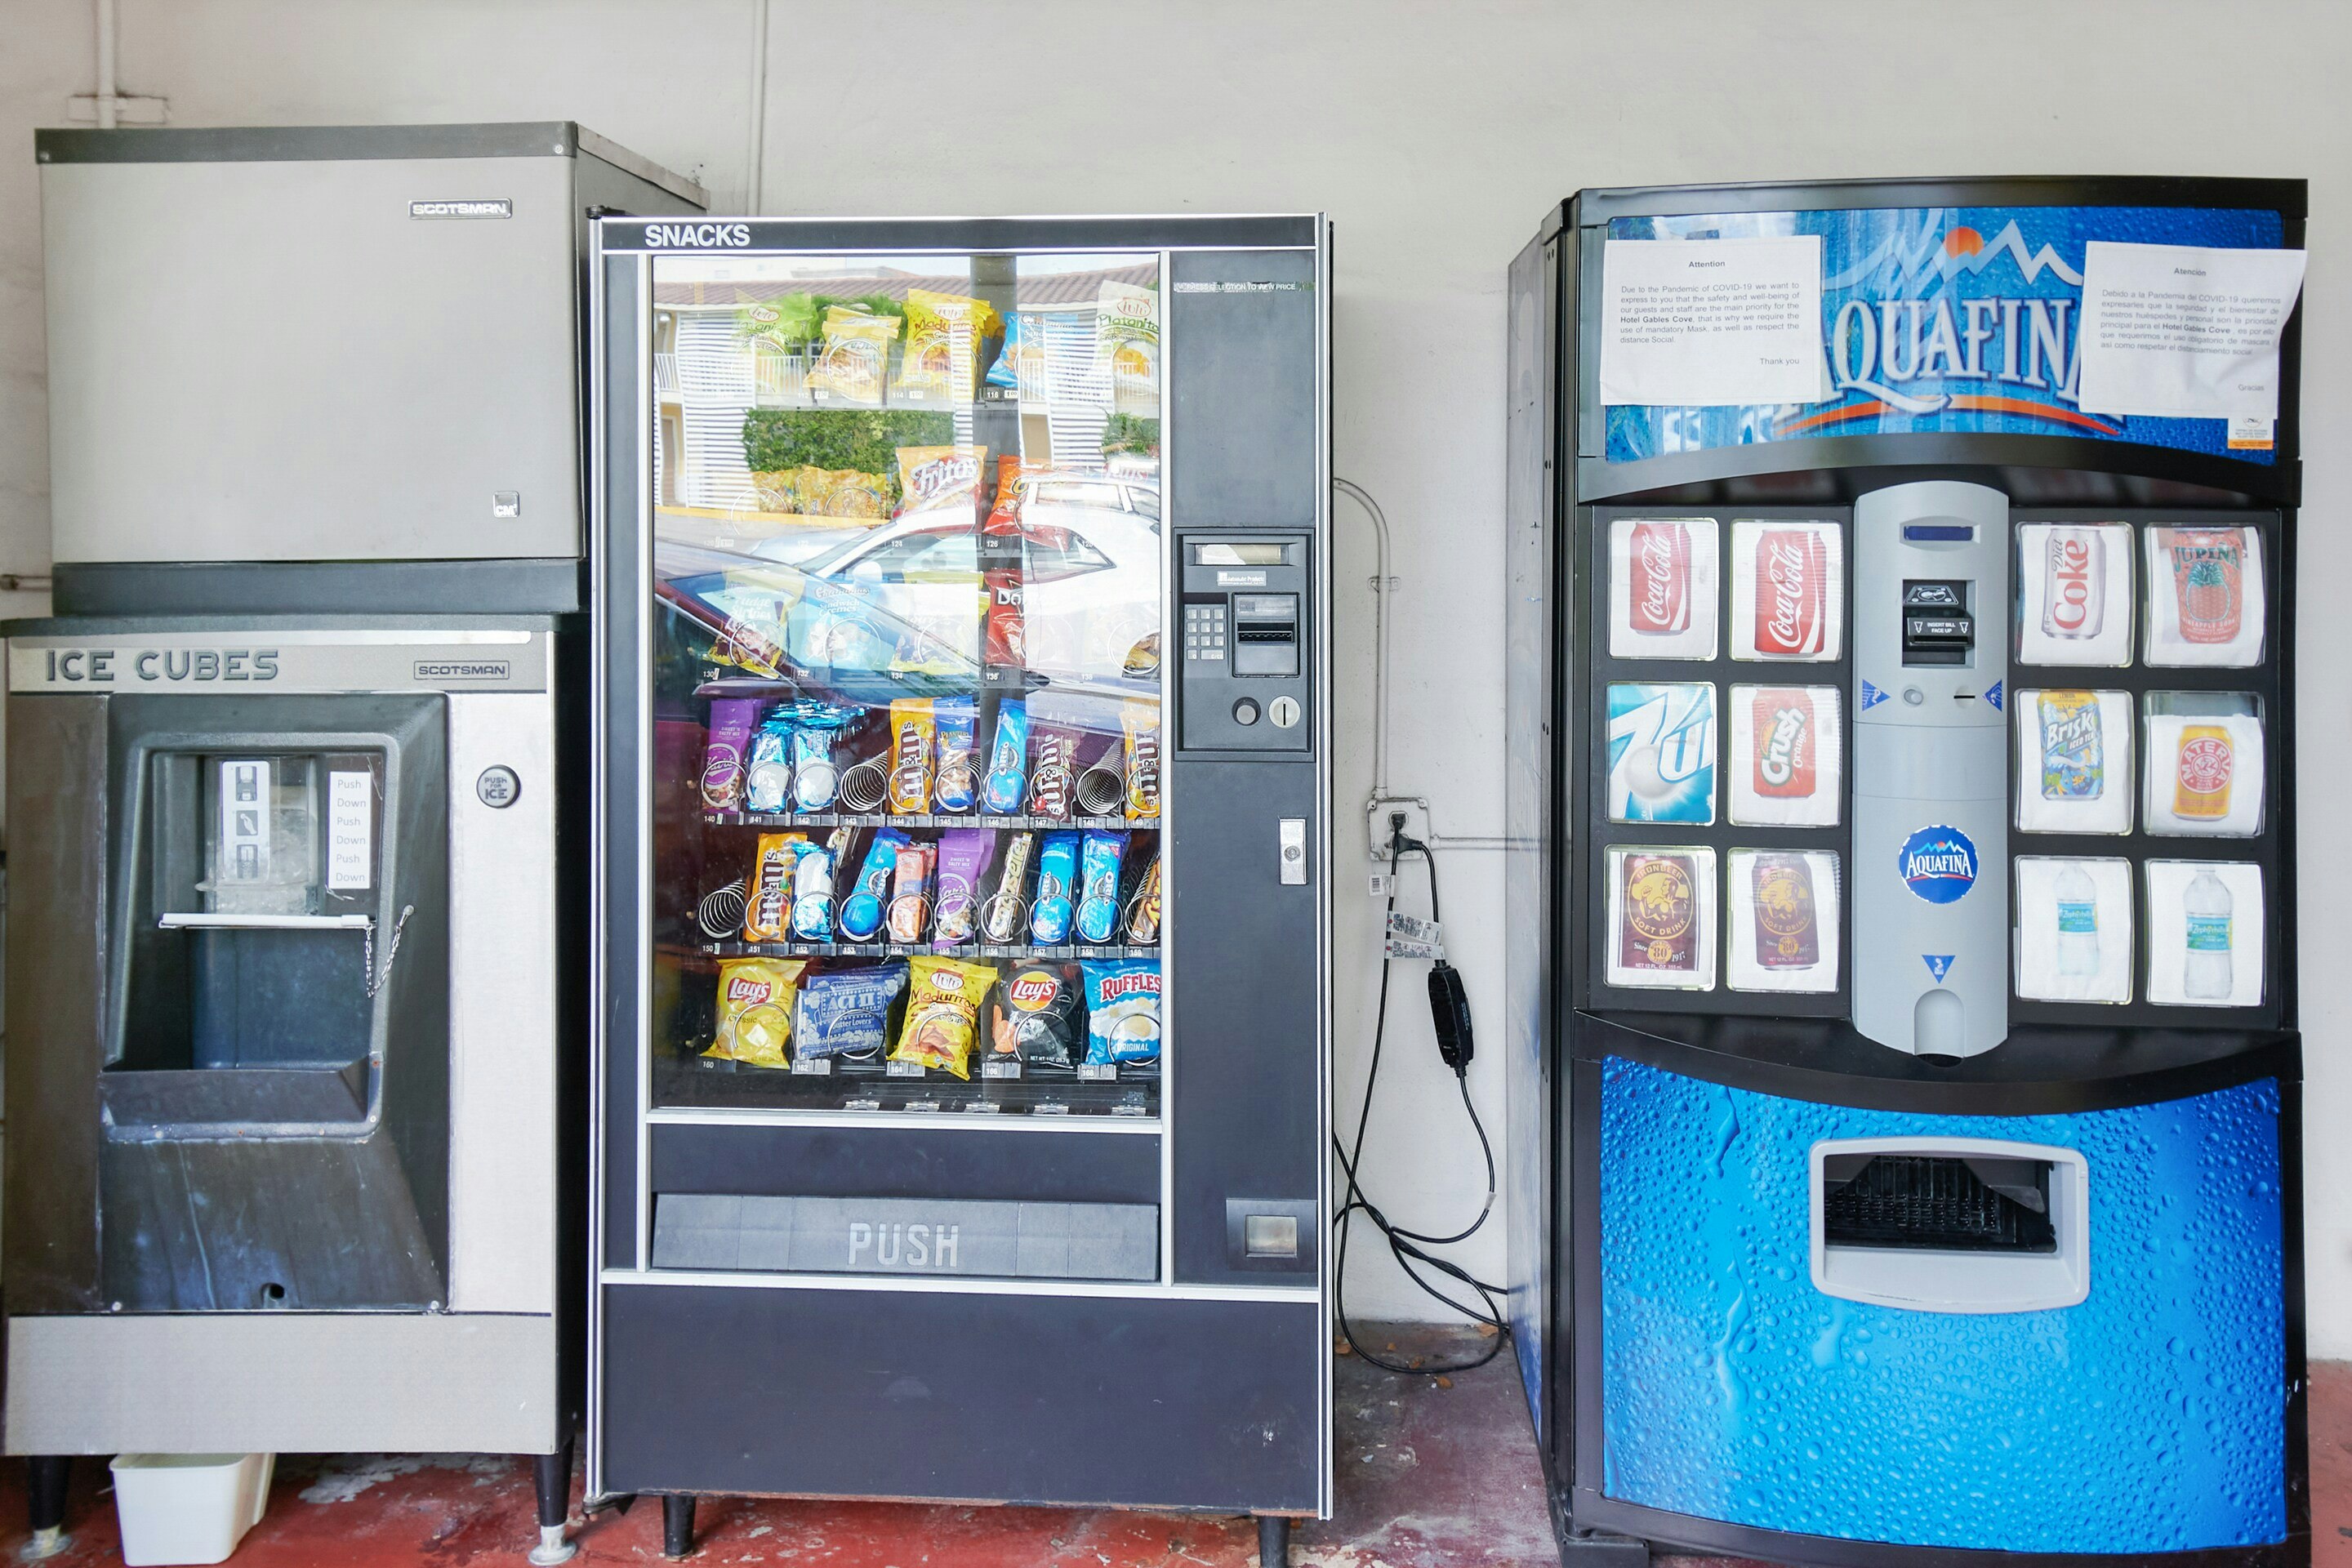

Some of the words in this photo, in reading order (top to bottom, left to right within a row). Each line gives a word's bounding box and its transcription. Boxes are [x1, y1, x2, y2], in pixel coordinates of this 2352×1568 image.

[412, 203, 506, 215] SCOTSMAN
[645, 225, 751, 247] SNACKS
[1688, 260, 1725, 268] Attention
[1276, 283, 1296, 291] PRICE
[1621, 285, 1635, 293] Due
[1638, 285, 1645, 293] to
[1662, 284, 1699, 292] Pandemic
[1702, 283, 1709, 292] of
[1713, 283, 1752, 292] COVID-19
[1770, 282, 1788, 290] want
[1792, 282, 1799, 290] to
[1620, 296, 1647, 305] express
[1650, 295, 1657, 303] to
[1659, 296, 1673, 305] you
[1675, 294, 1690, 302] that
[1692, 294, 1704, 302] the
[1707, 293, 1730, 303] safety
[1749, 292, 1788, 302] well-being
[1792, 292, 1799, 300] of
[1634, 305, 1657, 315] guests
[1659, 305, 1673, 313] and
[1709, 304, 1722, 312] the
[1724, 303, 1743, 311] main
[1745, 302, 1771, 313] priority
[1774, 302, 1784, 310] for
[1620, 315, 1640, 323] Hotel
[1698, 314, 1712, 322] that
[1724, 314, 1740, 323] why
[1757, 313, 1784, 323] require
[1787, 312, 1799, 320] the
[1635, 325, 1643, 333] of
[1646, 324, 1684, 335] mandatory
[1725, 323, 1740, 332] well
[1756, 323, 1784, 332] respect
[1619, 336, 1649, 344] distance
[1759, 357, 1783, 365] Thank
[1785, 359, 1799, 367] you
[911, 458, 979, 495] Fritos
[2052, 538, 2063, 572] Diet
[2174, 541, 2240, 572] JUPIÑA
[1642, 530, 1672, 626] Coca-Cola
[2053, 539, 2089, 630] Coke
[1768, 539, 1804, 648] Coca-Cola
[46, 649, 115, 681] ICE
[134, 649, 278, 681] CUBES
[418, 666, 506, 675] SCOTSMAN
[703, 670, 714, 678] 130
[797, 670, 809, 678] 132
[1081, 672, 1093, 680] 138
[1761, 707, 1807, 787] Crush
[1793, 727, 1808, 769] Orange
[2069, 737, 2082, 750] ICED
[899, 721, 925, 800] m&m's
[998, 741, 1010, 776] OREO
[2181, 742, 2230, 781] MATERVA
[337, 778, 362, 789] Push
[485, 788, 508, 800] ICE
[336, 797, 367, 808] Down
[336, 816, 361, 826] Push
[336, 835, 366, 845] Down
[336, 853, 360, 864] Push
[1905, 850, 1974, 880] AQUAFINA
[336, 871, 365, 882] Down
[1040, 871, 1052, 905] OREO
[1635, 917, 1655, 934] SOFT
[1659, 918, 1686, 935] DRINK
[1764, 918, 1782, 931] SOFT
[1634, 942, 1648, 951] Since
[1653, 946, 1667, 958] 80
[729, 978, 770, 1004] Lay's
[1012, 980, 1054, 1001] Lay's
[1101, 973, 1160, 1002] RUFFLES
[827, 995, 858, 1013] ACT
[859, 992, 875, 1009] II
[853, 1018, 871, 1027] Lovers
[1116, 1042, 1149, 1052] ORIGINAL
[848, 1221, 960, 1268] PUSH
